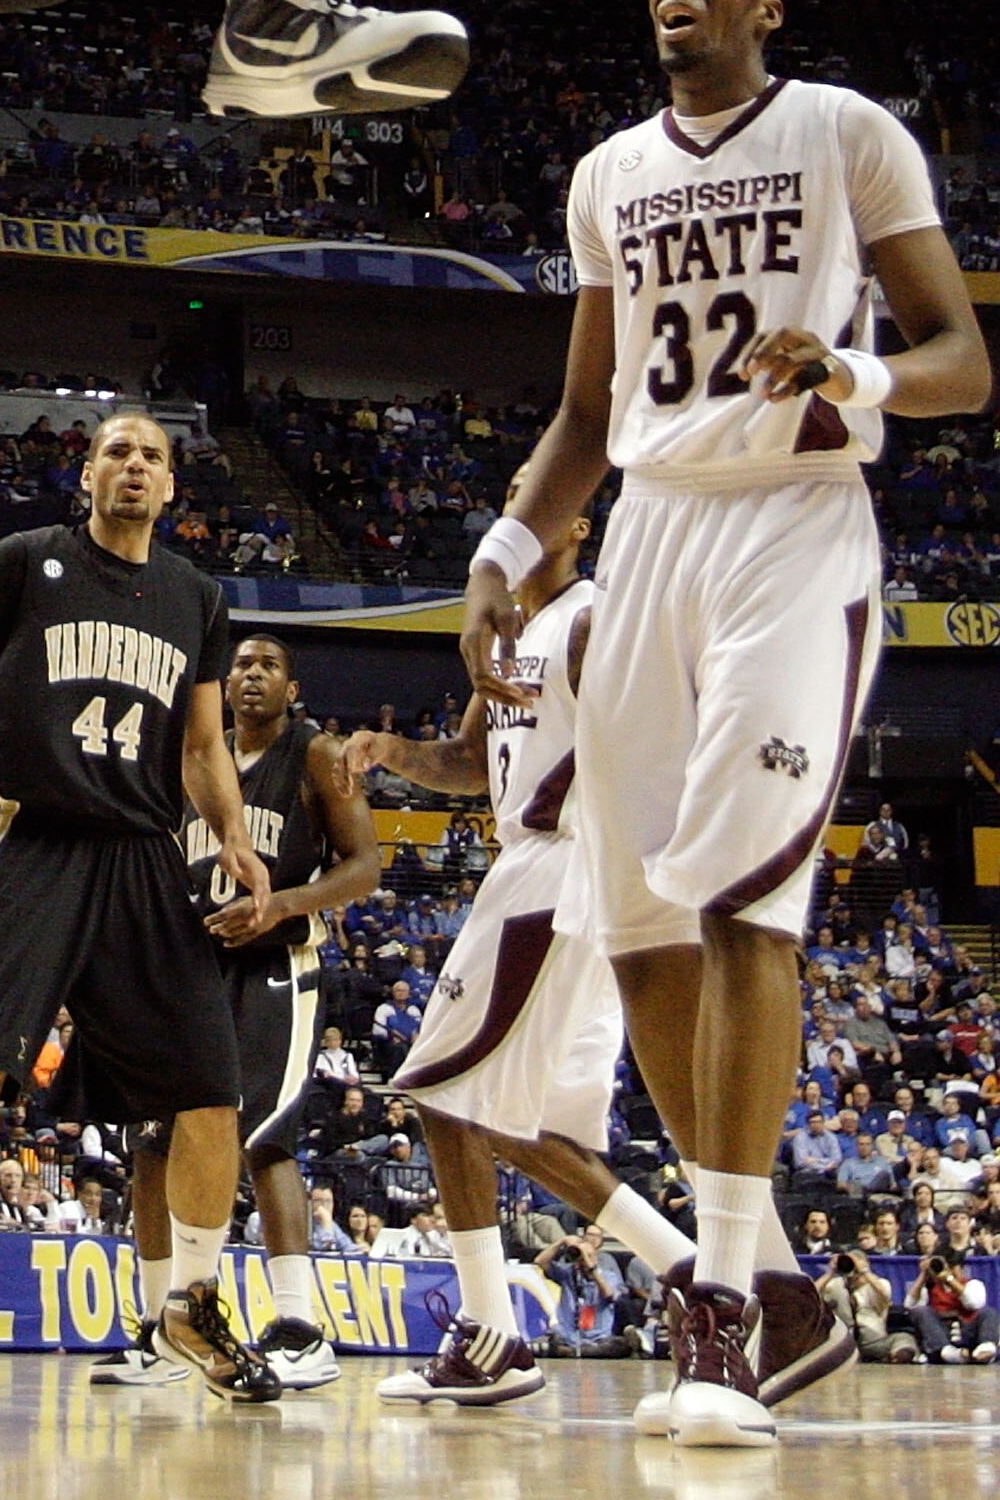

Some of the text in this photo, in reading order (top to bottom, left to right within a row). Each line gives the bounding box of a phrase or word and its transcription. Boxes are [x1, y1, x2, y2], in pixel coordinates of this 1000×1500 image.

[366, 120, 403, 143] 303
[615, 171, 802, 233] MISSISSIPPI
[620, 209, 802, 296] STATE
[254, 327, 290, 349] 203
[648, 290, 756, 406] 32
[949, 604, 1000, 645] SEC
[44, 621, 187, 709] VANDERBILT
[72, 696, 144, 761] 44
[31, 1239, 409, 1348] TOUNAENT
